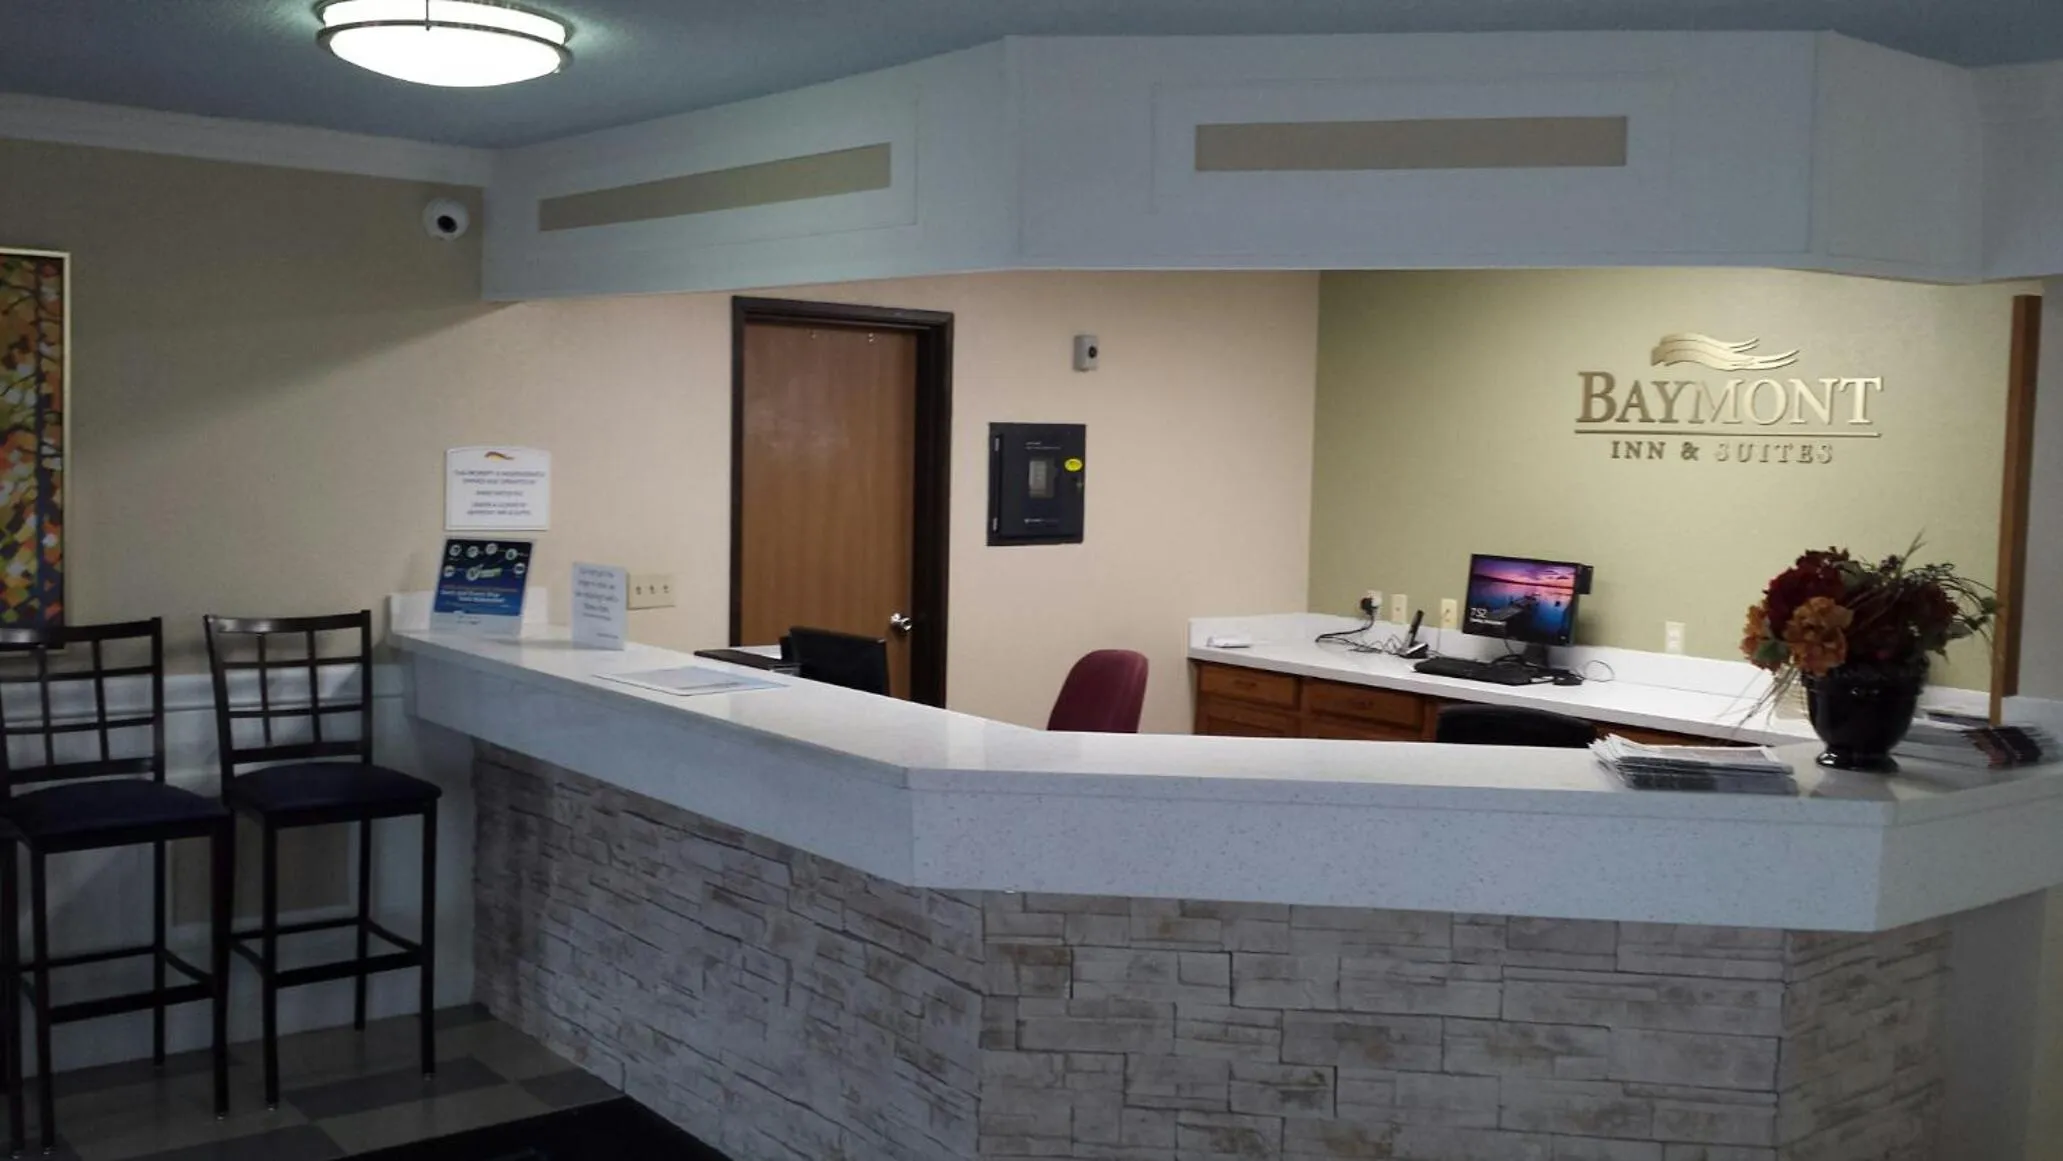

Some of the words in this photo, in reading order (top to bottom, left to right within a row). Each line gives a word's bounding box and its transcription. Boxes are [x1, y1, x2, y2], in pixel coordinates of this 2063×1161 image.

[1575, 371, 1883, 426] BAYMONT
[1611, 440, 1666, 460] INN
[1680, 441, 1700, 462] &
[1715, 443, 1834, 465] SUITES
